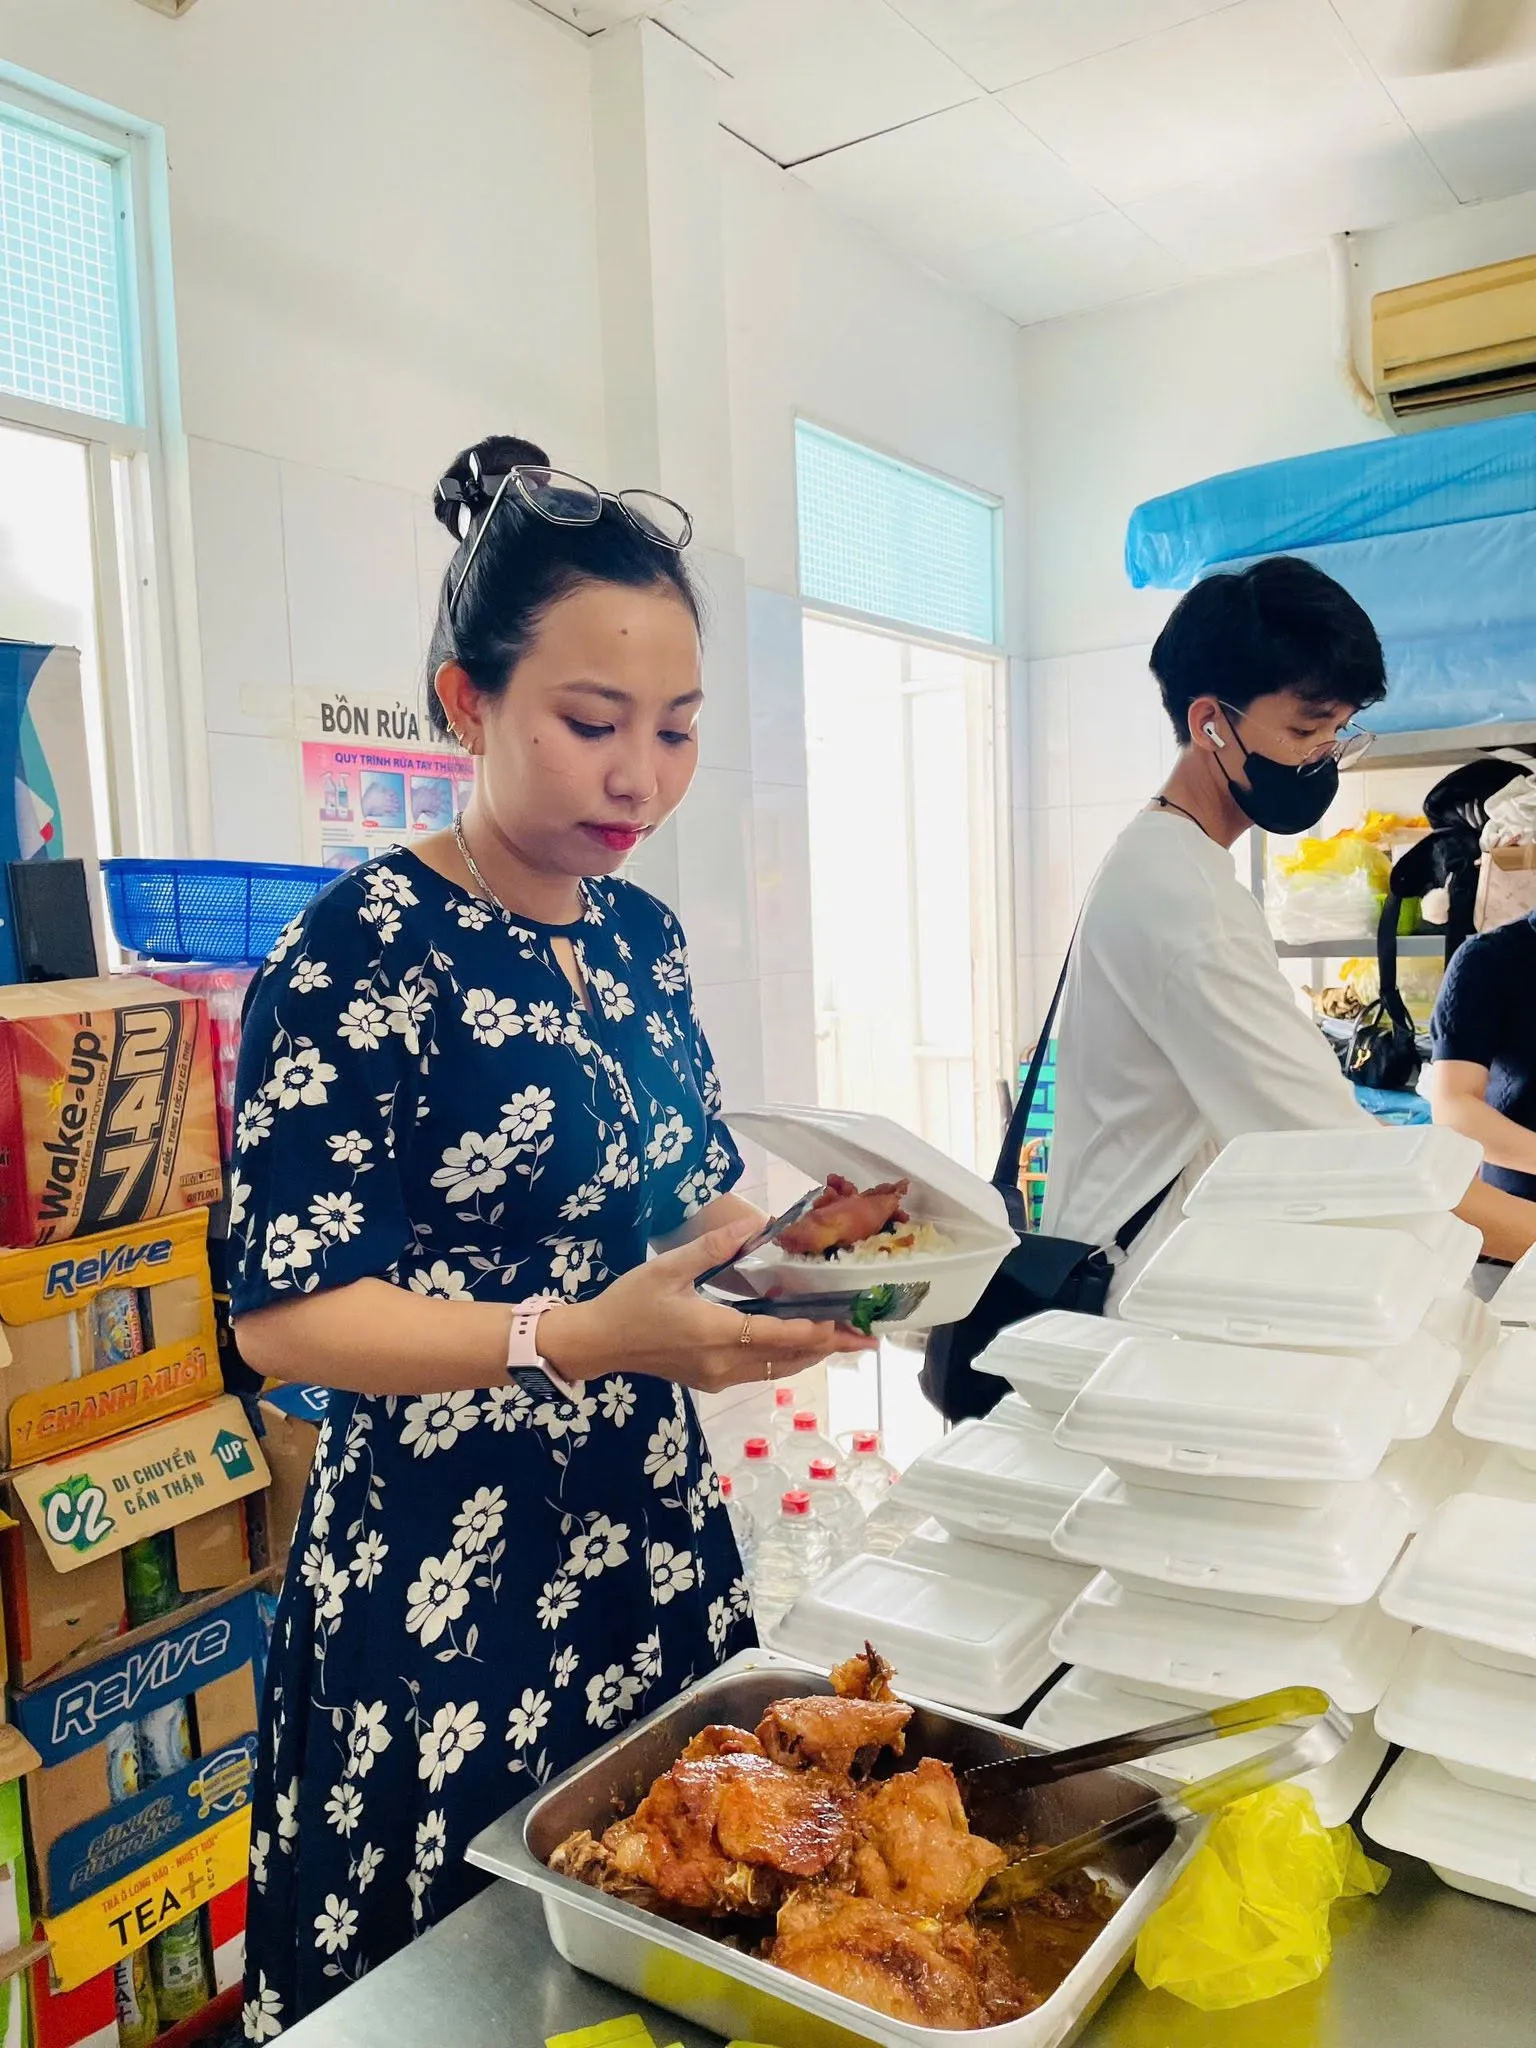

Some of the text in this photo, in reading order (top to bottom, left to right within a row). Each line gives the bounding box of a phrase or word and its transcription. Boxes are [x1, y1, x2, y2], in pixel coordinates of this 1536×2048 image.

[321, 694, 369, 736] BỒN
[377, 701, 420, 741] RỬA
[335, 752, 357, 764] QUY
[72, 1063, 109, 1217] the coffee innovator
[36, 1379, 139, 1436] CHANH
[112, 1447, 197, 1493] DI CHUYỂN
[218, 1440, 243, 1464] UP
[161, 1471, 205, 1499] THẬN
[45, 1486, 113, 1544] C2
[129, 1876, 151, 1898] LONG
